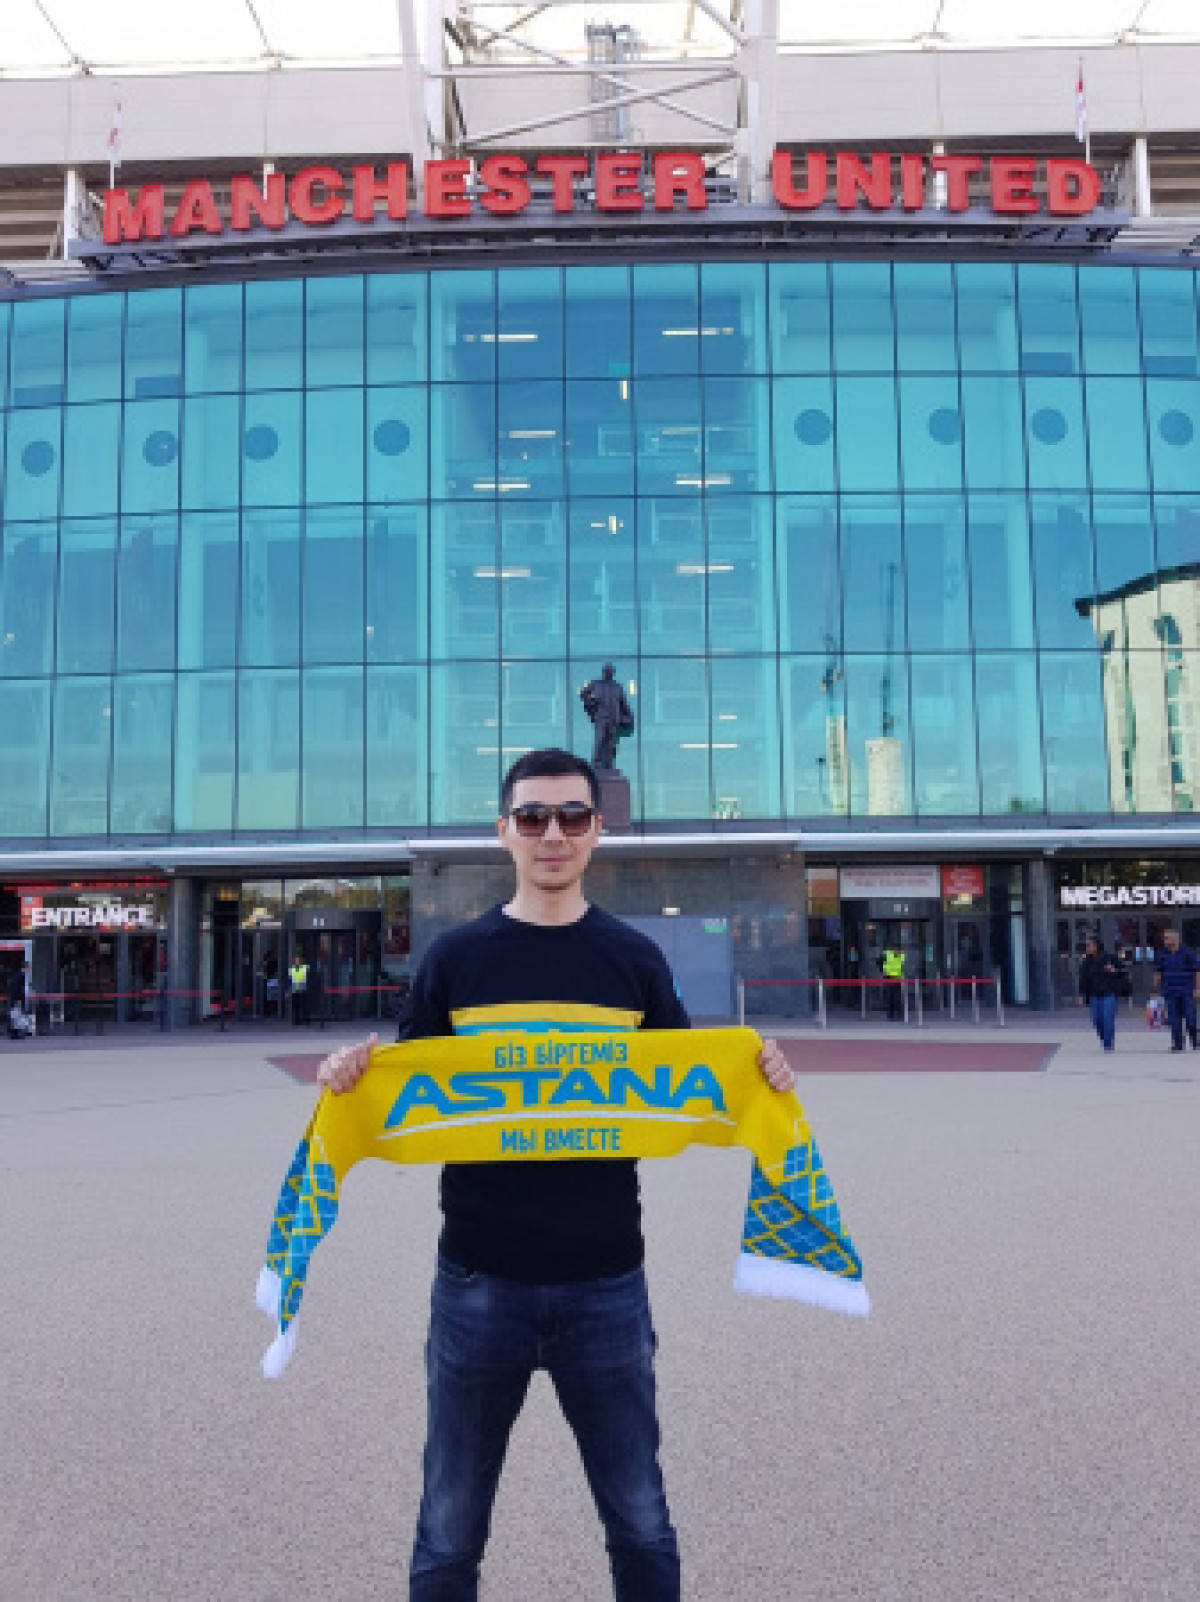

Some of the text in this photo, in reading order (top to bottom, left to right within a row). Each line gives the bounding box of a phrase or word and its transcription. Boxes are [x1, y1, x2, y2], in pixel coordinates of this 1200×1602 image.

[103, 149, 1100, 244] MANCHESTER UNITED
[31, 907, 154, 927] ENTRANCE
[384, 1065, 726, 1129] ASTANA
[501, 1127, 623, 1152] МЫ ВМЕСТЕ
